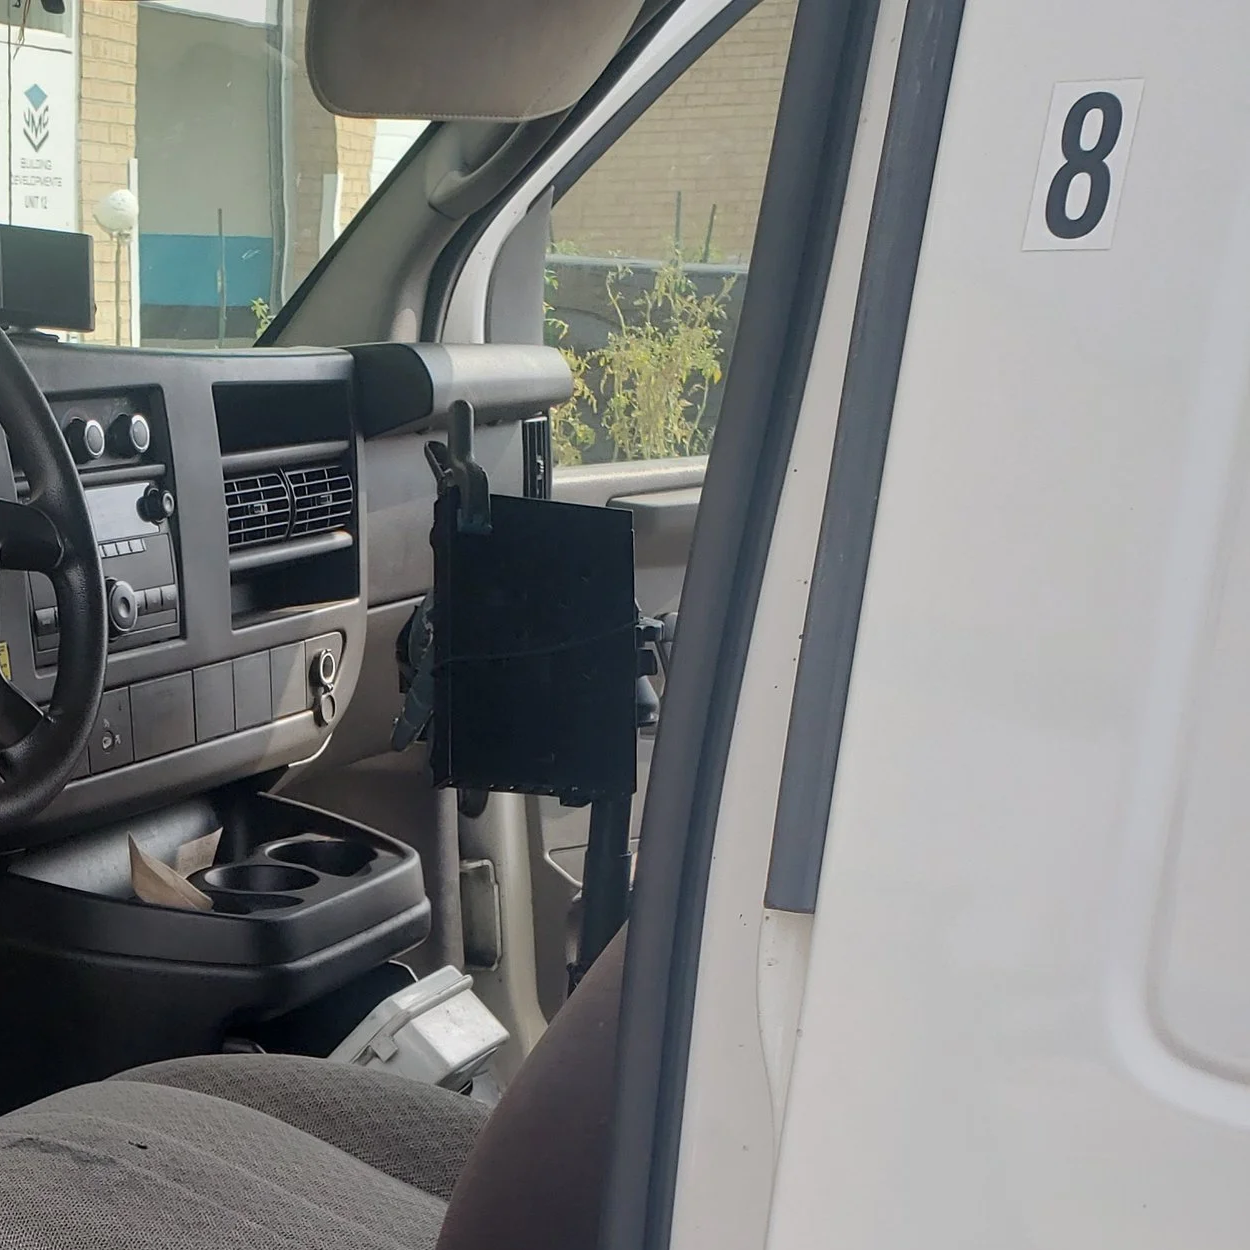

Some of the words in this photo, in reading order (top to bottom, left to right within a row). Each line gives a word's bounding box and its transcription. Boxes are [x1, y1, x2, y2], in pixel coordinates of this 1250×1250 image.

[20, 157, 53, 171] BUILDING
[1045, 91, 1122, 239] 8
[24, 195, 39, 209] UNIT
